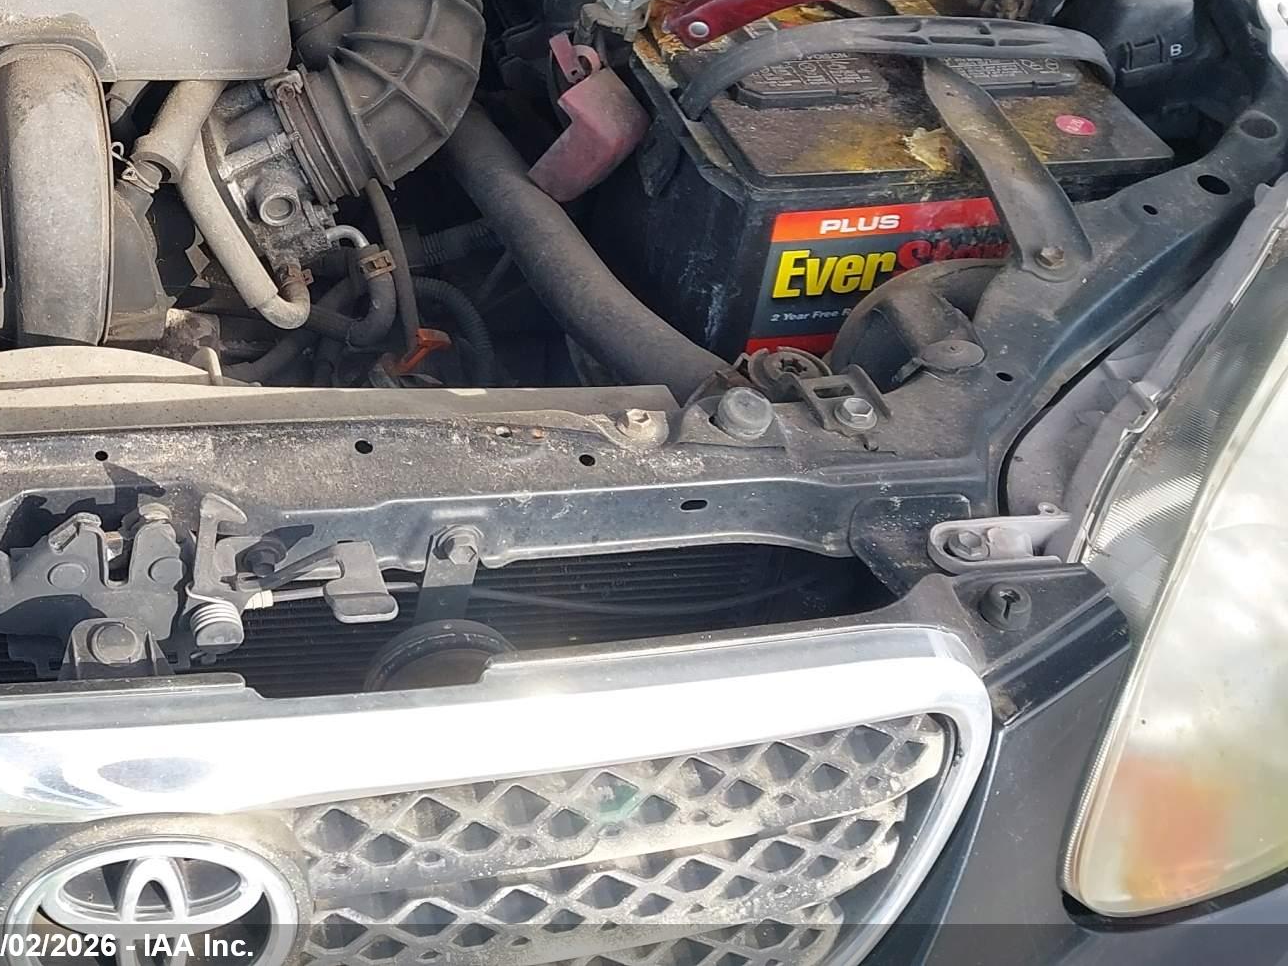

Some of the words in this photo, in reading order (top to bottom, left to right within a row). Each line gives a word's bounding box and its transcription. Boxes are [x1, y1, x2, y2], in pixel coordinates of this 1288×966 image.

[1170, 43, 1182, 57] B
[819, 213, 901, 235] PLUS
[769, 313, 780, 322] 2
[782, 311, 810, 321] Year
[812, 309, 839, 319] Free
